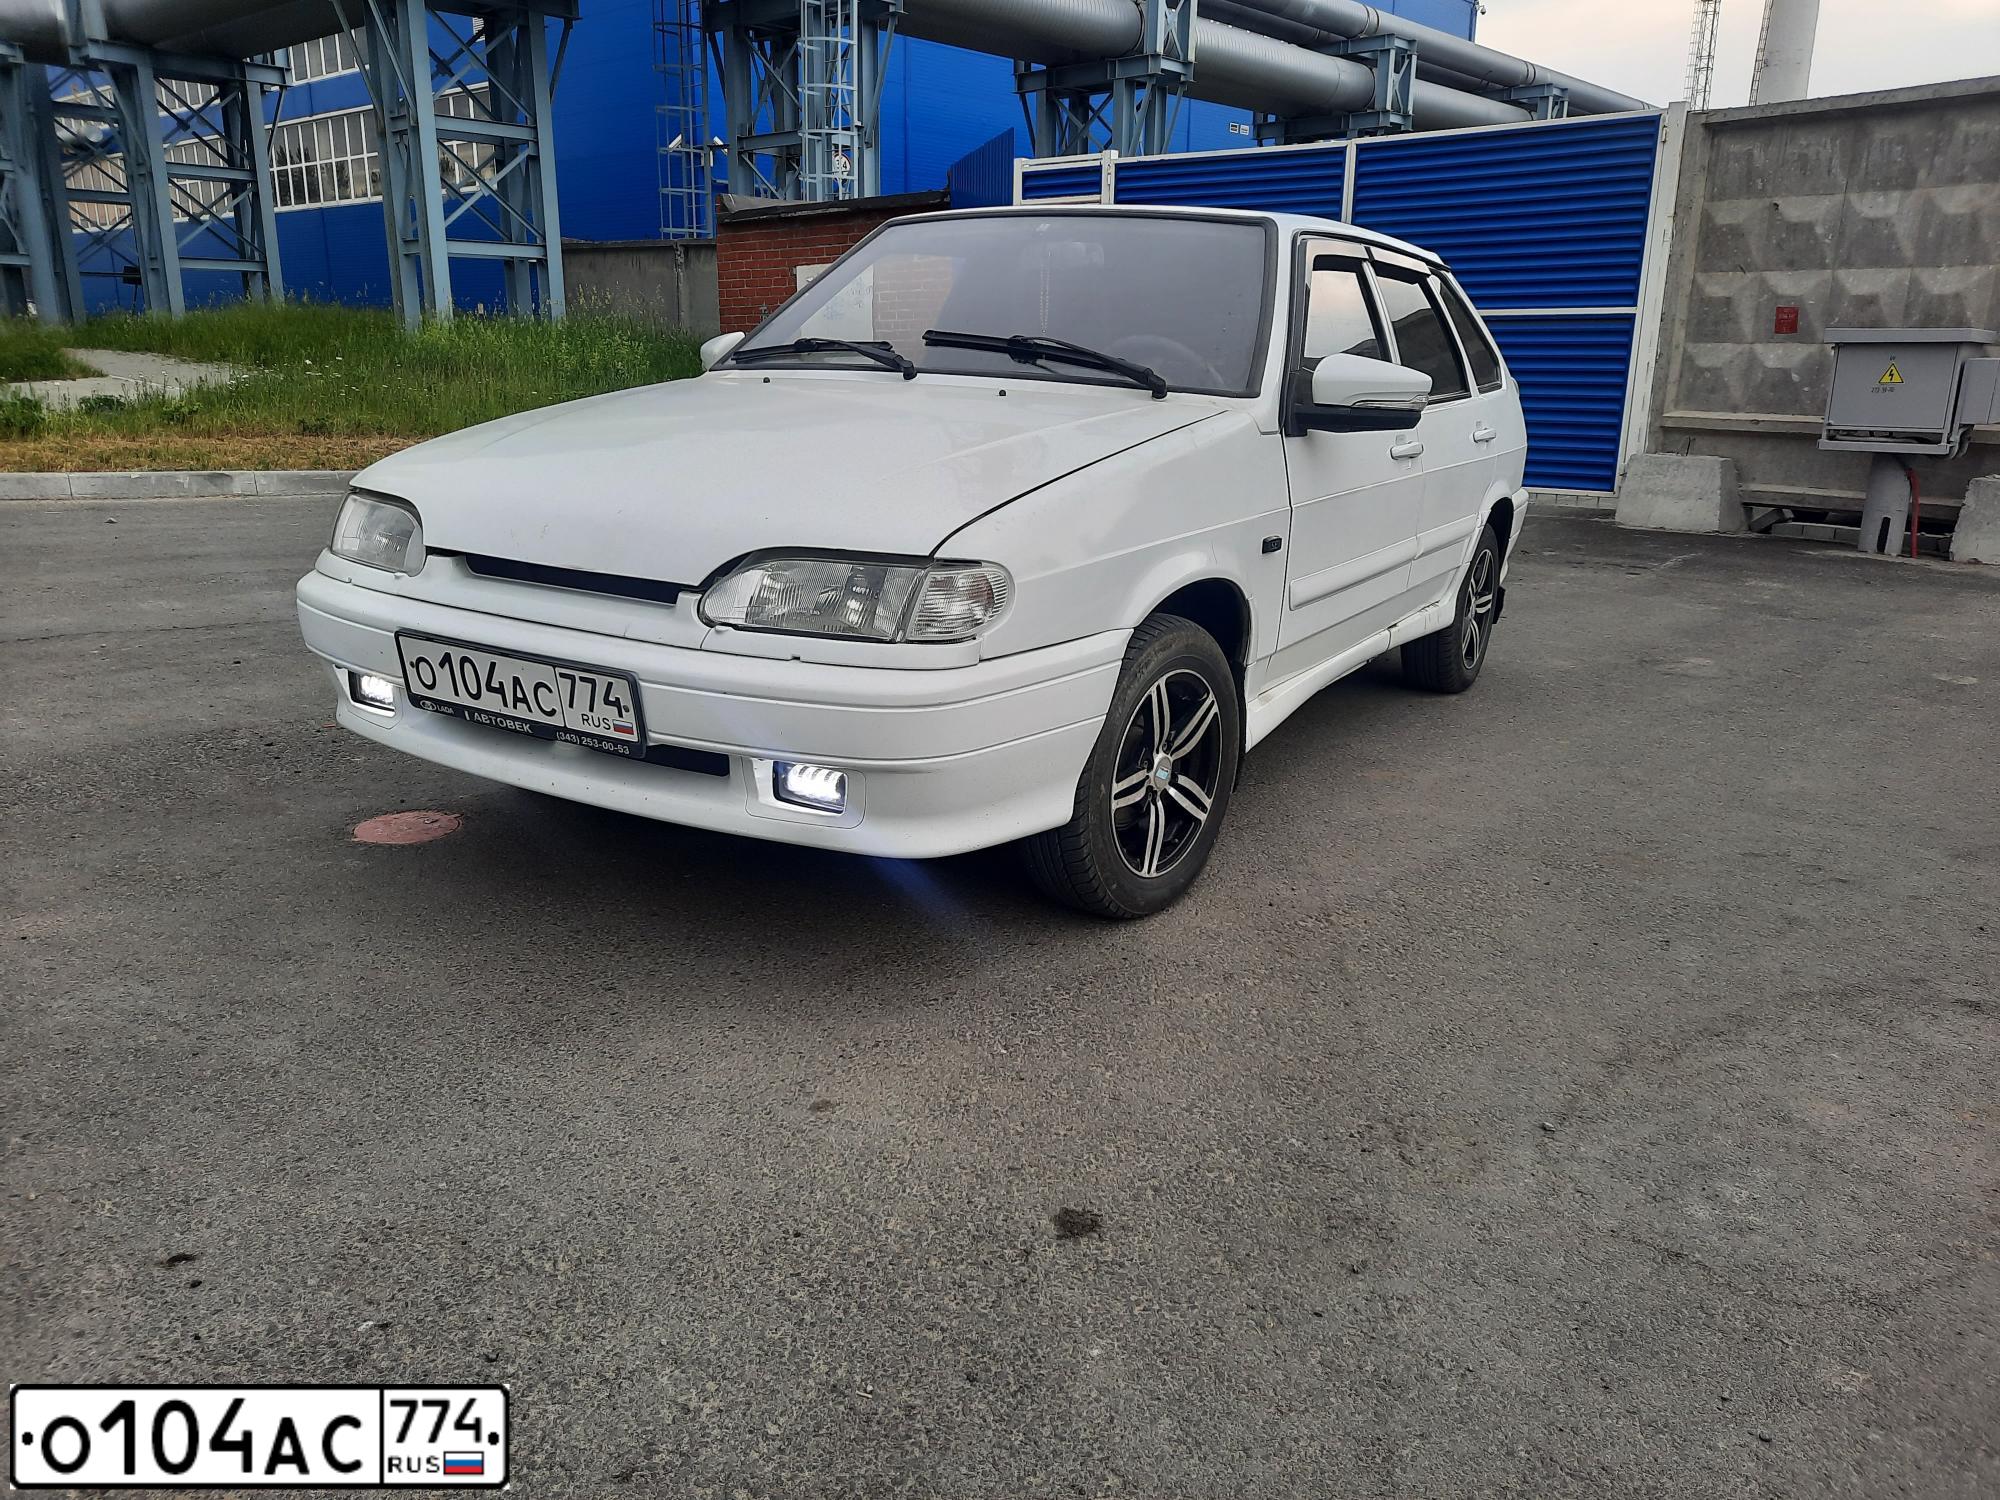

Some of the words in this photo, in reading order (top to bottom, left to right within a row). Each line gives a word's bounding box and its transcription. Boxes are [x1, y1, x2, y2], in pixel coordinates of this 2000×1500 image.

[559, 672, 624, 718] 774
[437, 705, 454, 714] LADA
[581, 713, 611, 730] RUS
[556, 731, 580, 745] (343)
[581, 736, 630, 754] 253-00-53
